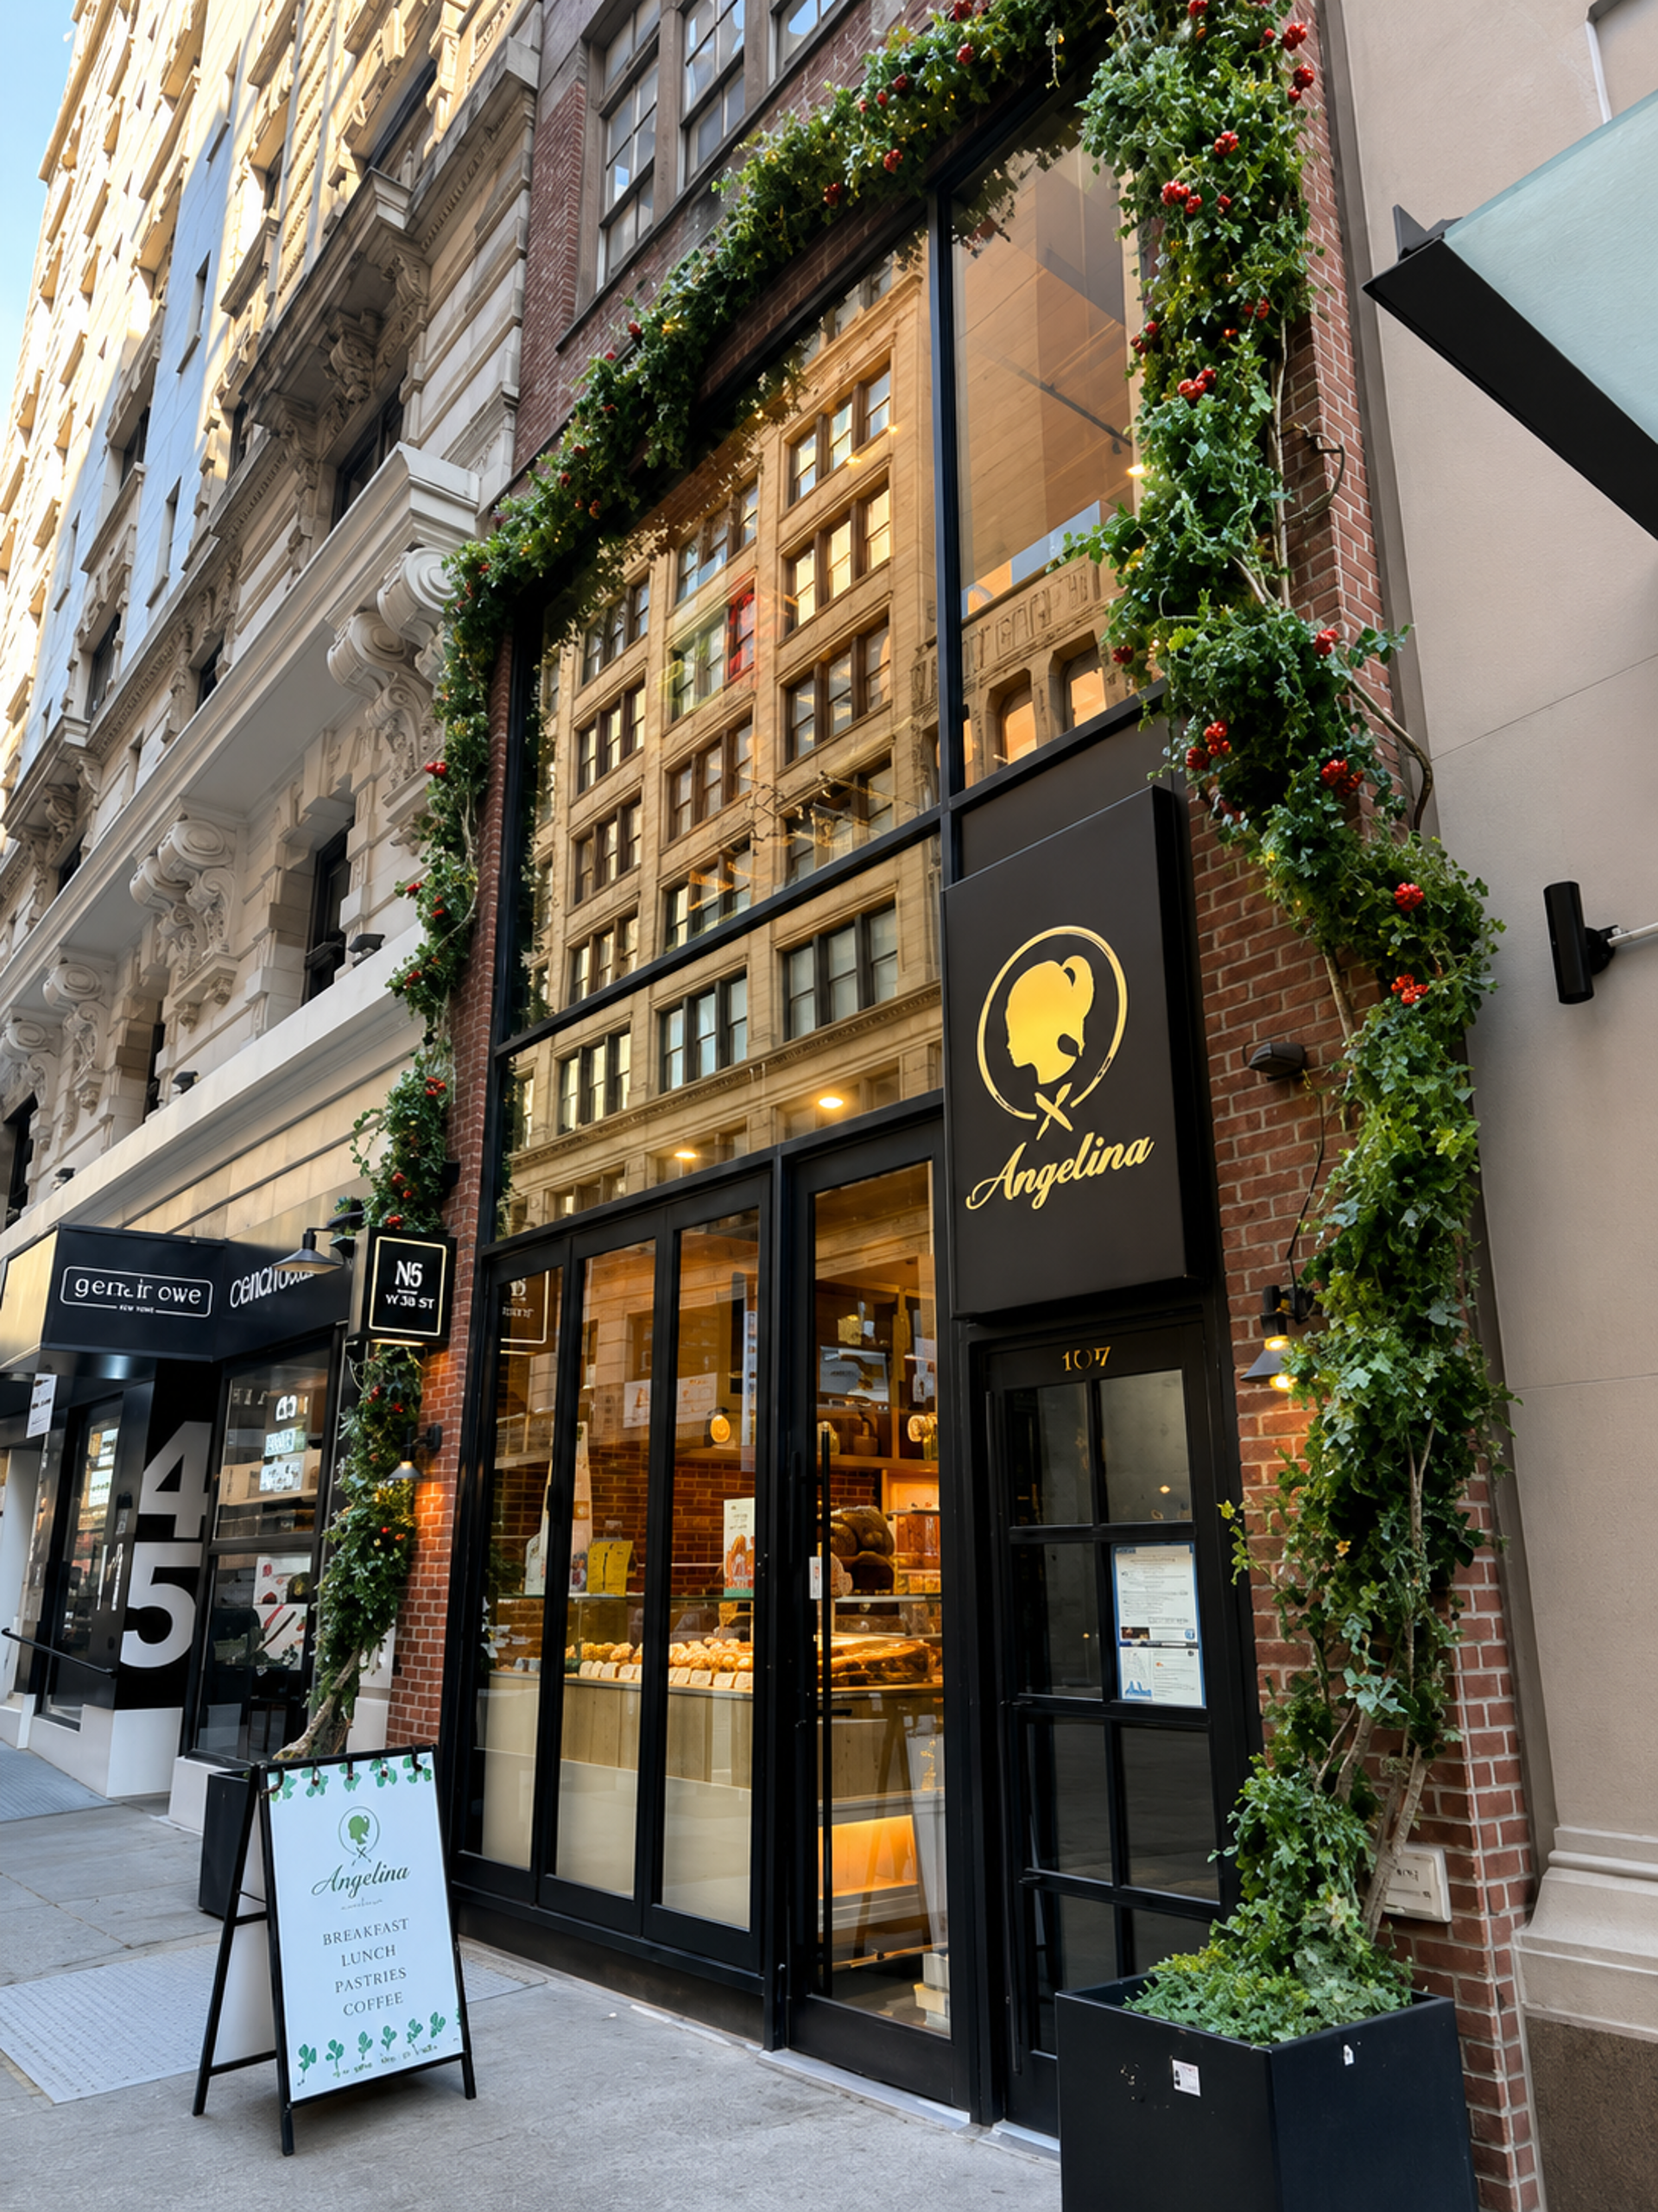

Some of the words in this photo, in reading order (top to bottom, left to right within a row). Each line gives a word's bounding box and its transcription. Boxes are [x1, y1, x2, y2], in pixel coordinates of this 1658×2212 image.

[965, 1131, 1155, 1210] Angelina
[418, 1297, 435, 1309] ST
[1061, 1346, 1111, 1372] 107
[311, 1860, 411, 1899] Angelina
[323, 1917, 409, 1946] BREAKFAST
[341, 1944, 396, 1968] LUNCH
[335, 1967, 407, 1993] PASTRIES
[343, 1991, 403, 2017] COFFEE
